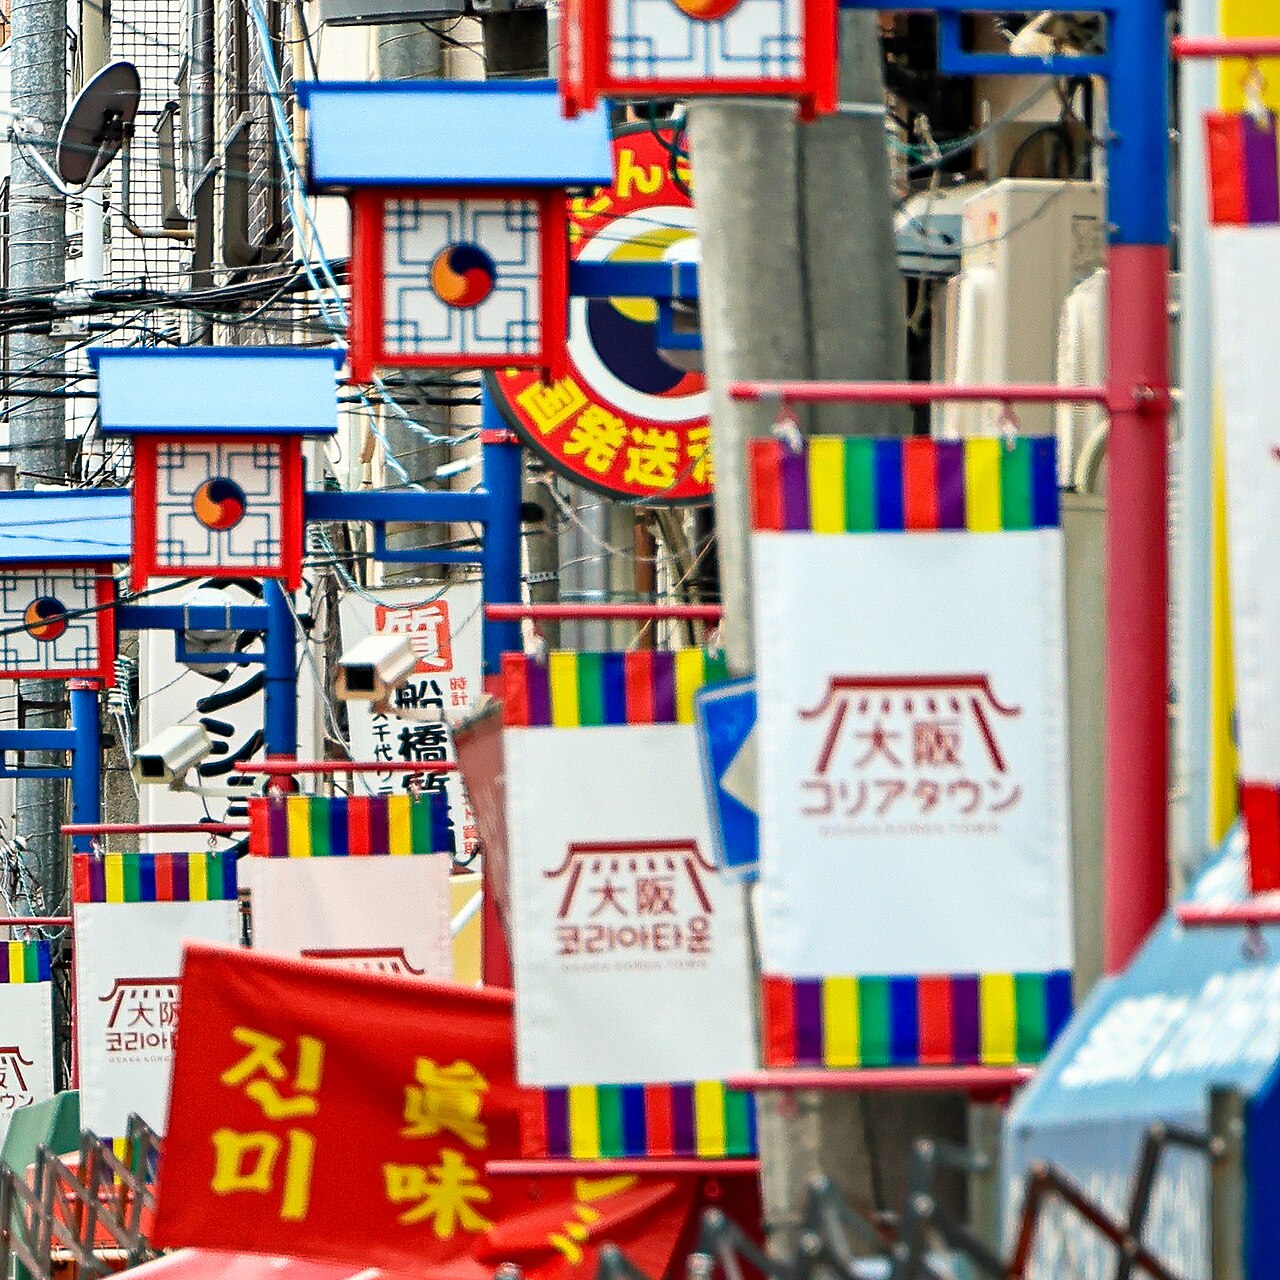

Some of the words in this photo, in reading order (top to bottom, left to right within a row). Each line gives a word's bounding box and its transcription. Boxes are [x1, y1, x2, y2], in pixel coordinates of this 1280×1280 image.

[852, 720, 963, 770] 大阪
[800, 778, 1023, 818] コリアタウン
[588, 876, 677, 917] 大阪
[555, 917, 710, 957] 코리아타운
[212, 1027, 326, 1222] 진미
